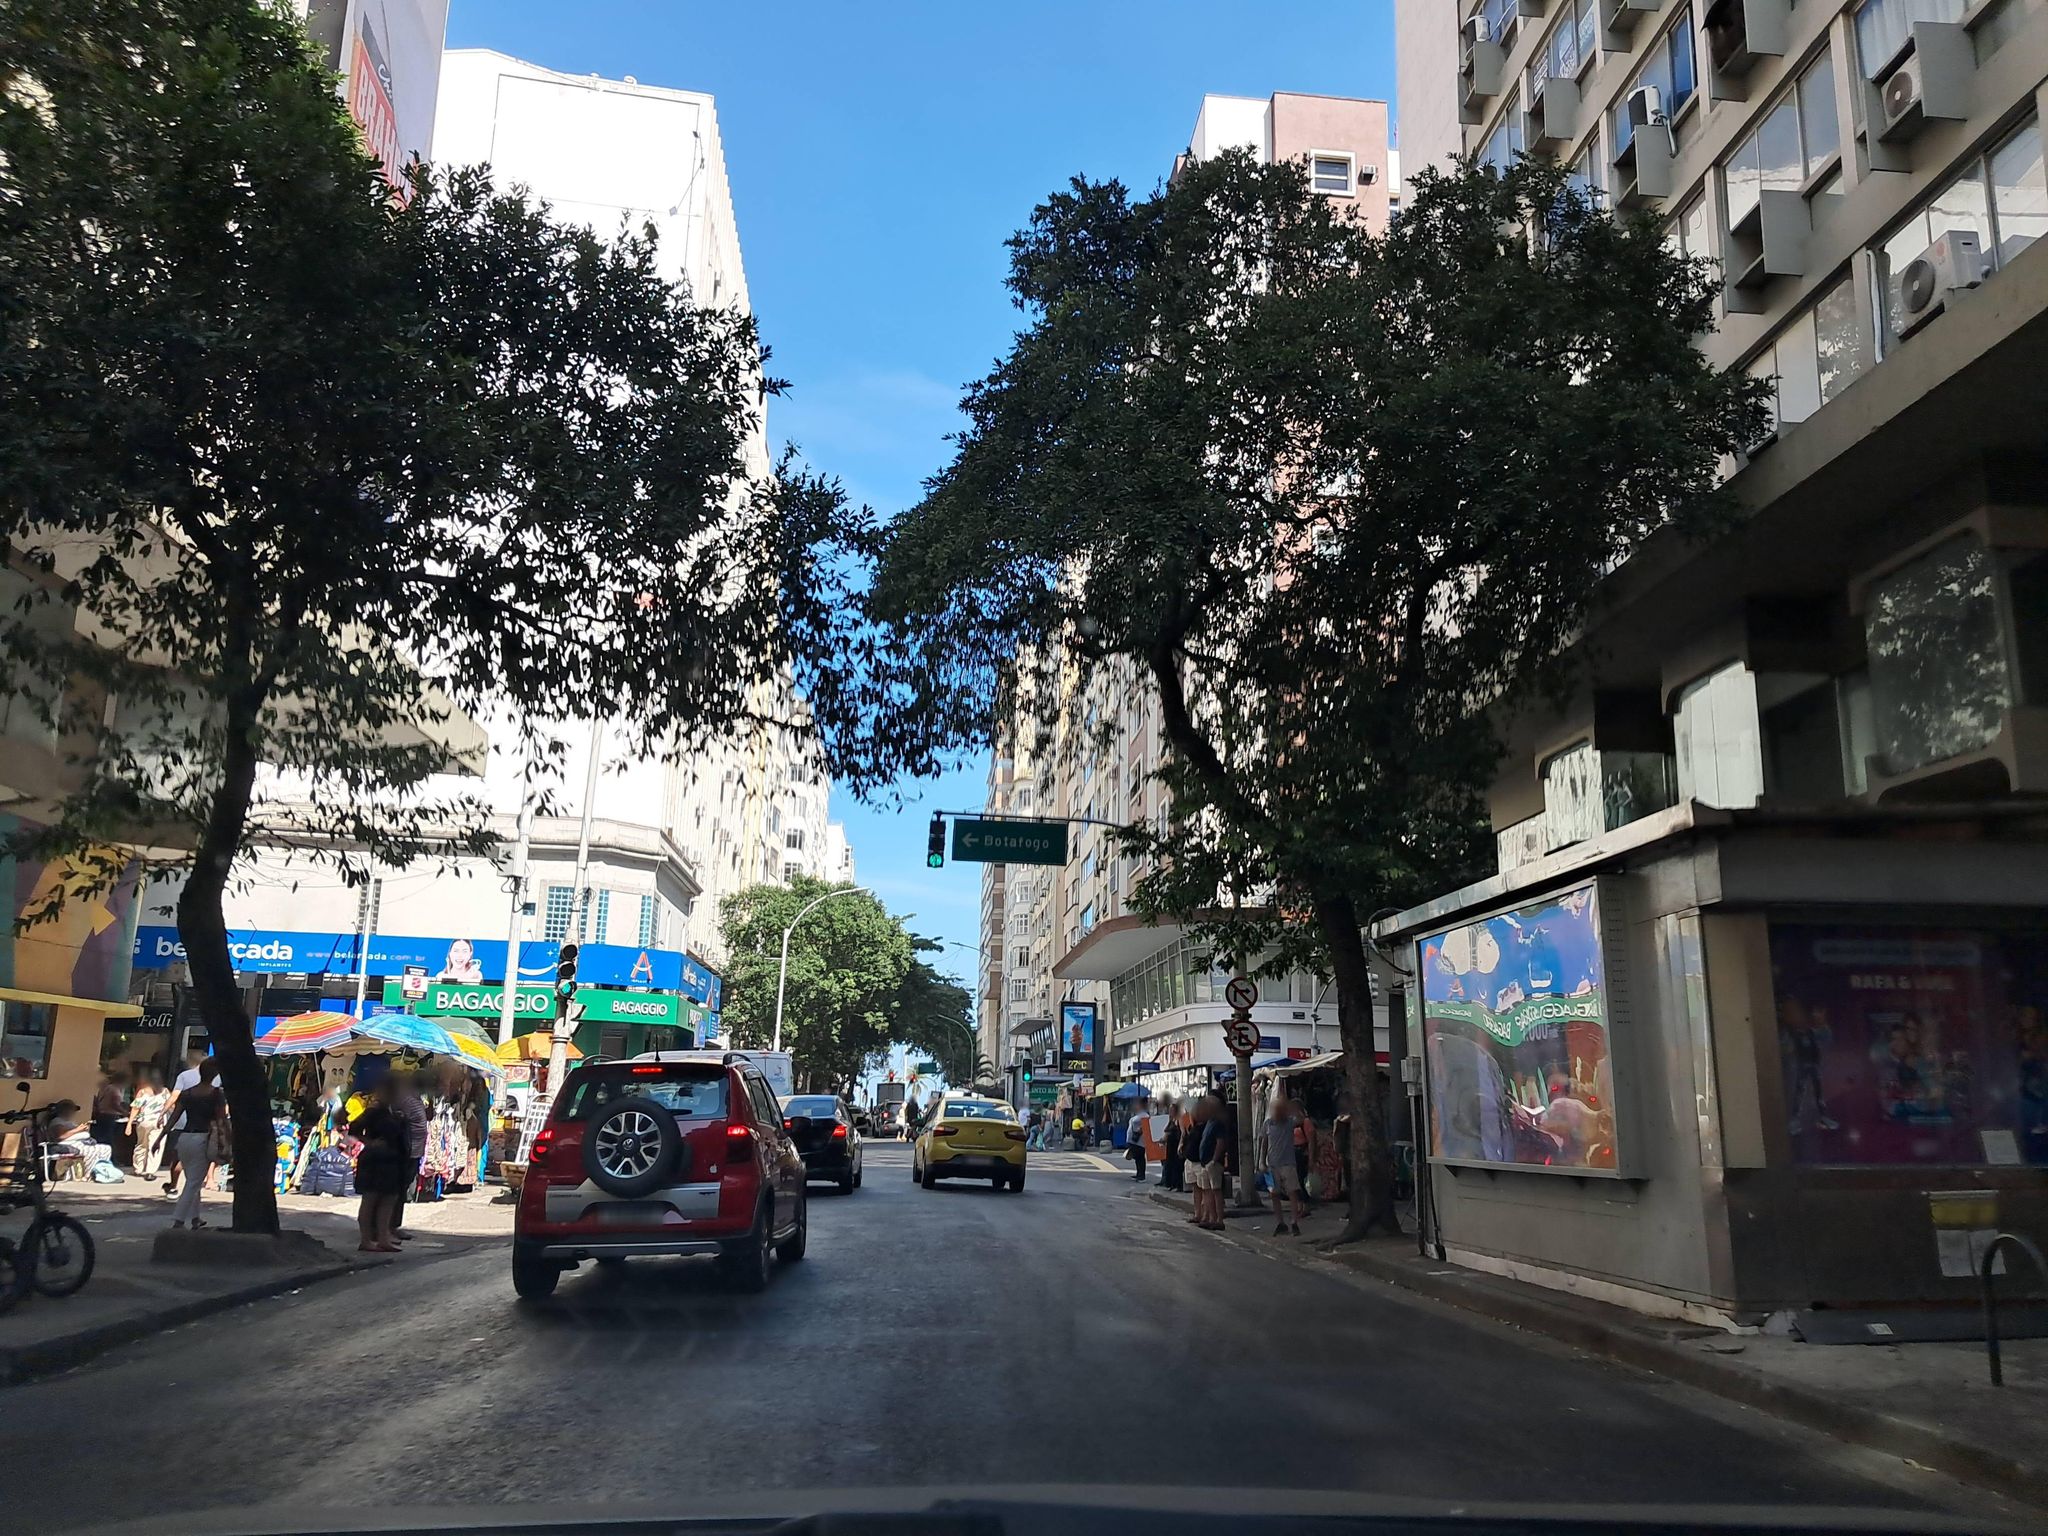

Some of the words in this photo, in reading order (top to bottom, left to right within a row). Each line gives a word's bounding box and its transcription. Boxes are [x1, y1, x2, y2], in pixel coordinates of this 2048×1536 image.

[984, 835, 1049, 852] Botafogo
[156, 936, 293, 960] becada
[612, 1000, 668, 1016] BAGAGGIO
